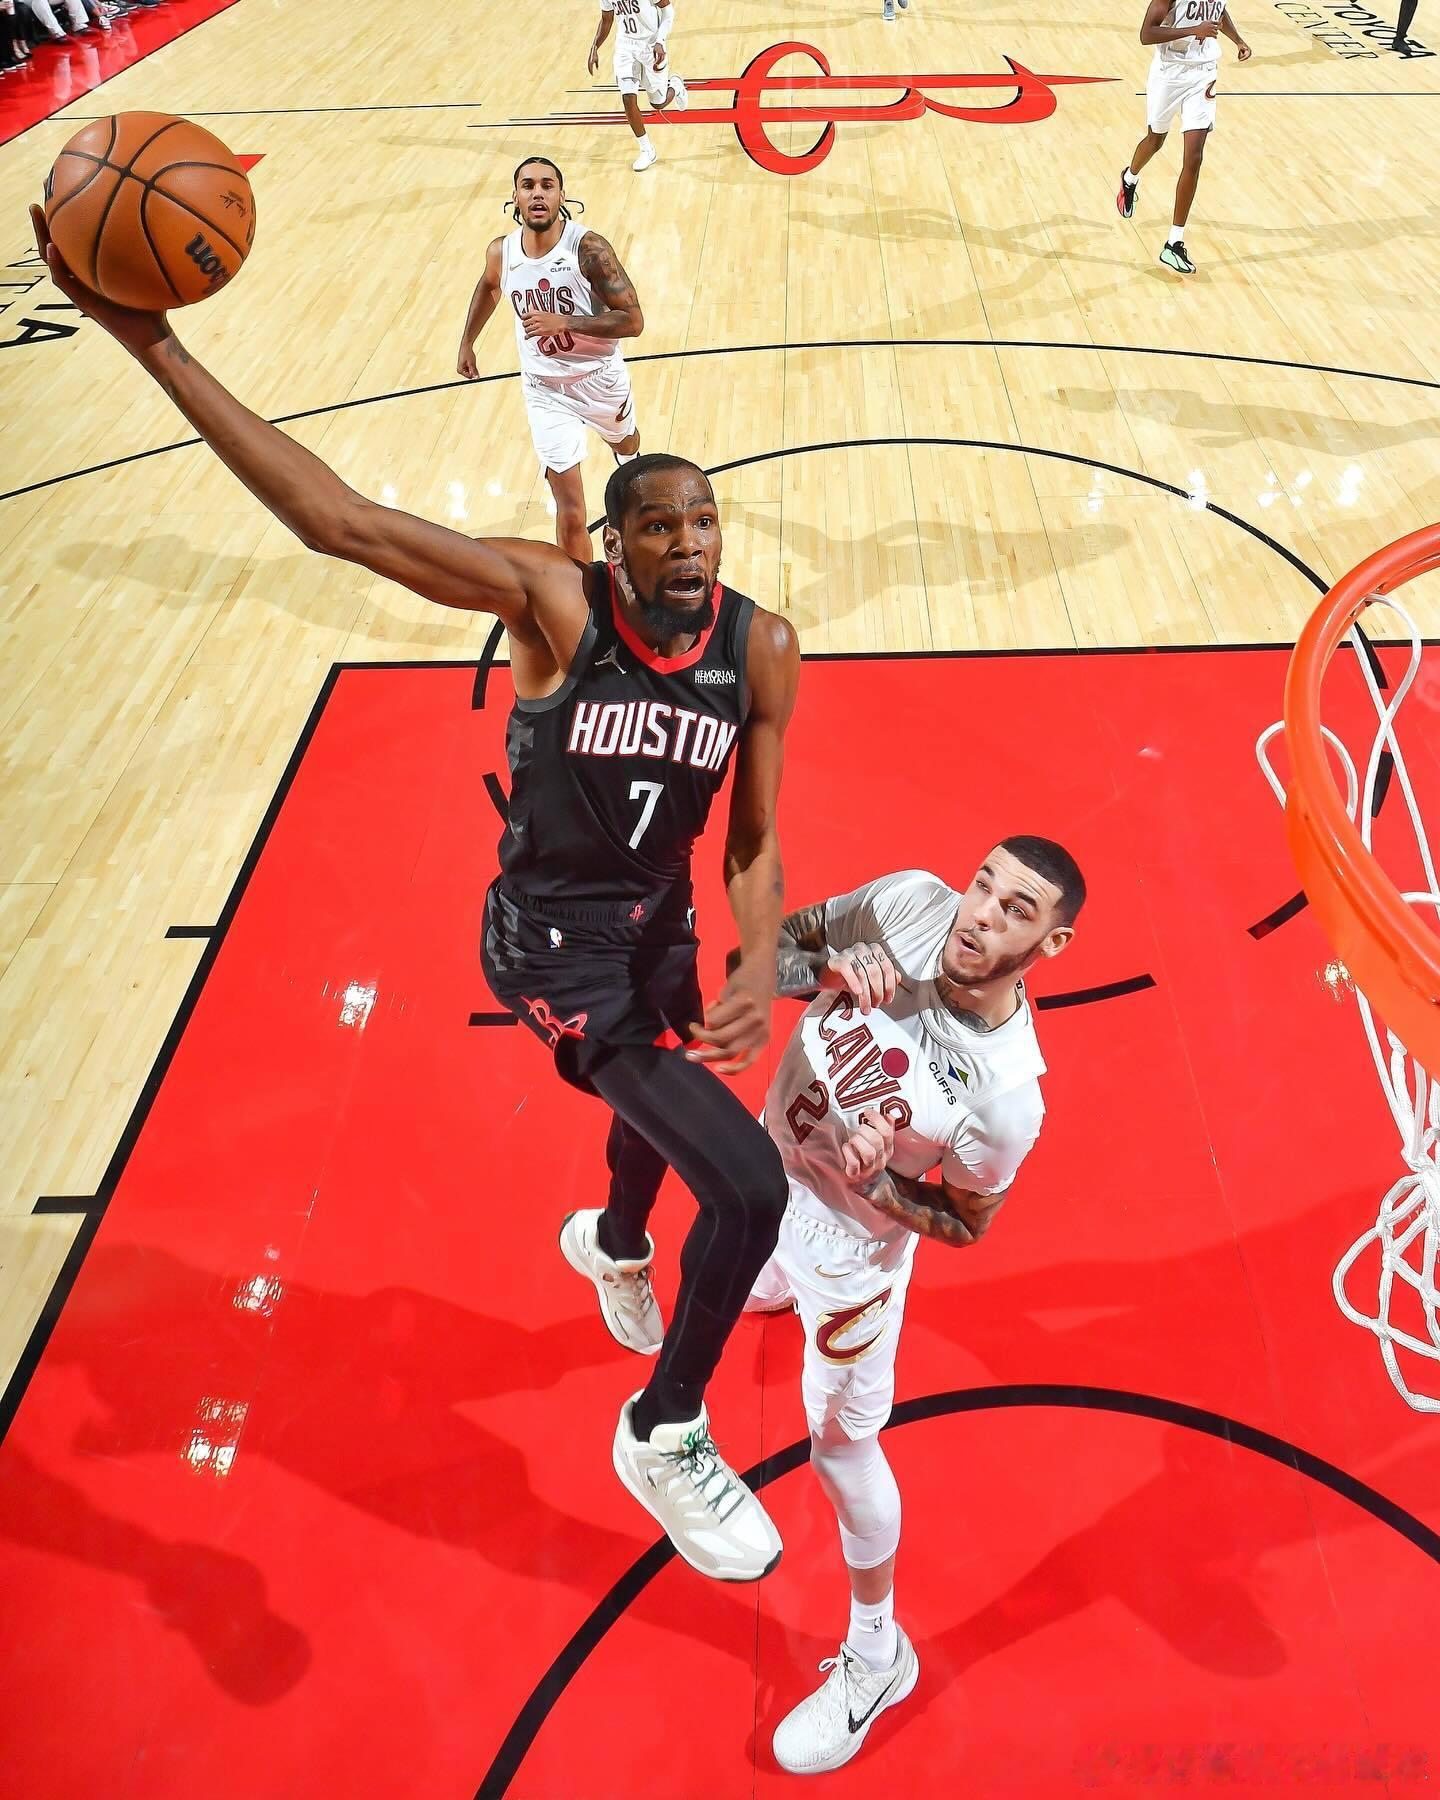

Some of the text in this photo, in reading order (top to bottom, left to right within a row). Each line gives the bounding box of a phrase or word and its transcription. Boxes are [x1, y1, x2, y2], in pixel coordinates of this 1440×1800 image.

[623, 17, 638, 34] 10
[1186, 0, 1222, 20] CAVS
[1274, 3, 1379, 59] CENTER
[511, 286, 575, 320] CAVS
[694, 669, 737, 678] MEMORIAL
[694, 675, 736, 684] HERMANN
[567, 700, 738, 772] HOUSTON
[628, 781, 665, 850] 7
[929, 1061, 957, 1106] CLIFFS
[785, 1079, 830, 1145] 2
